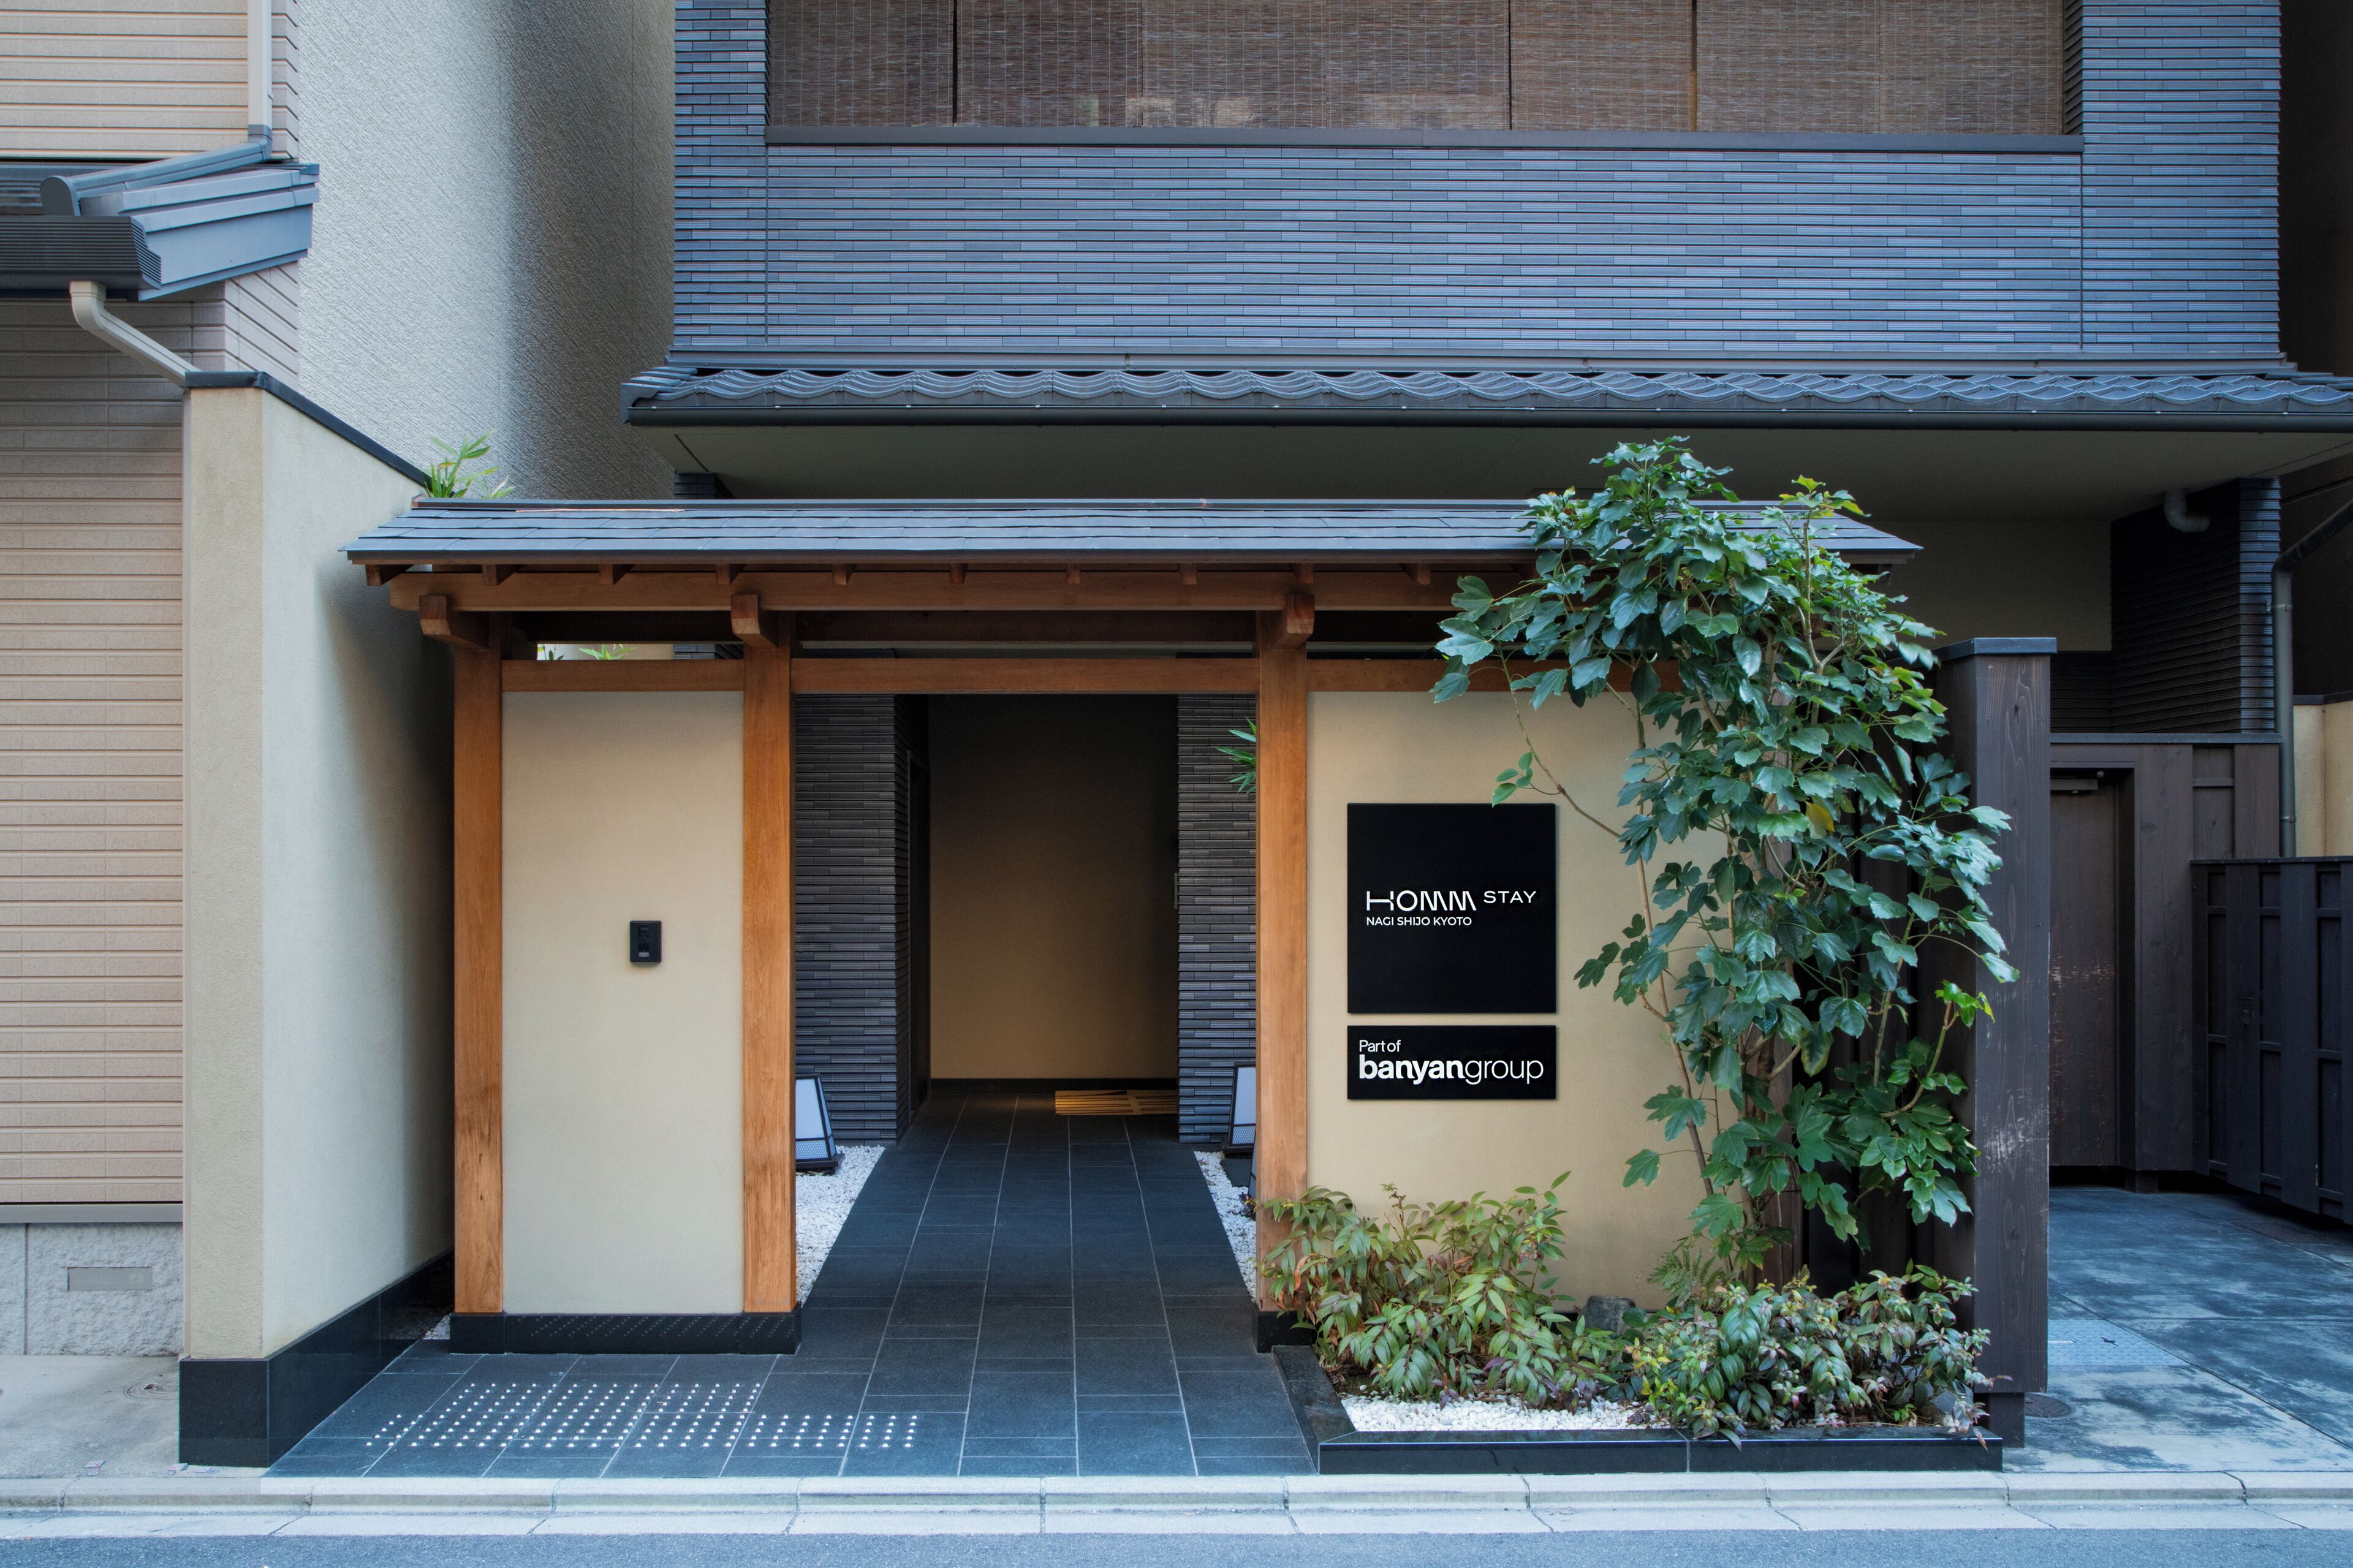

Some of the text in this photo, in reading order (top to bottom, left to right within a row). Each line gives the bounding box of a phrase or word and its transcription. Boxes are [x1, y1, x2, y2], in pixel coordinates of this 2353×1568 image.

[1366, 890, 1537, 912] HOMM STAY
[1366, 917, 1472, 926] NAGI SHIJO KYOTO
[1359, 1039, 1401, 1053] Part of
[1359, 1054, 1544, 1085] banyangroup
